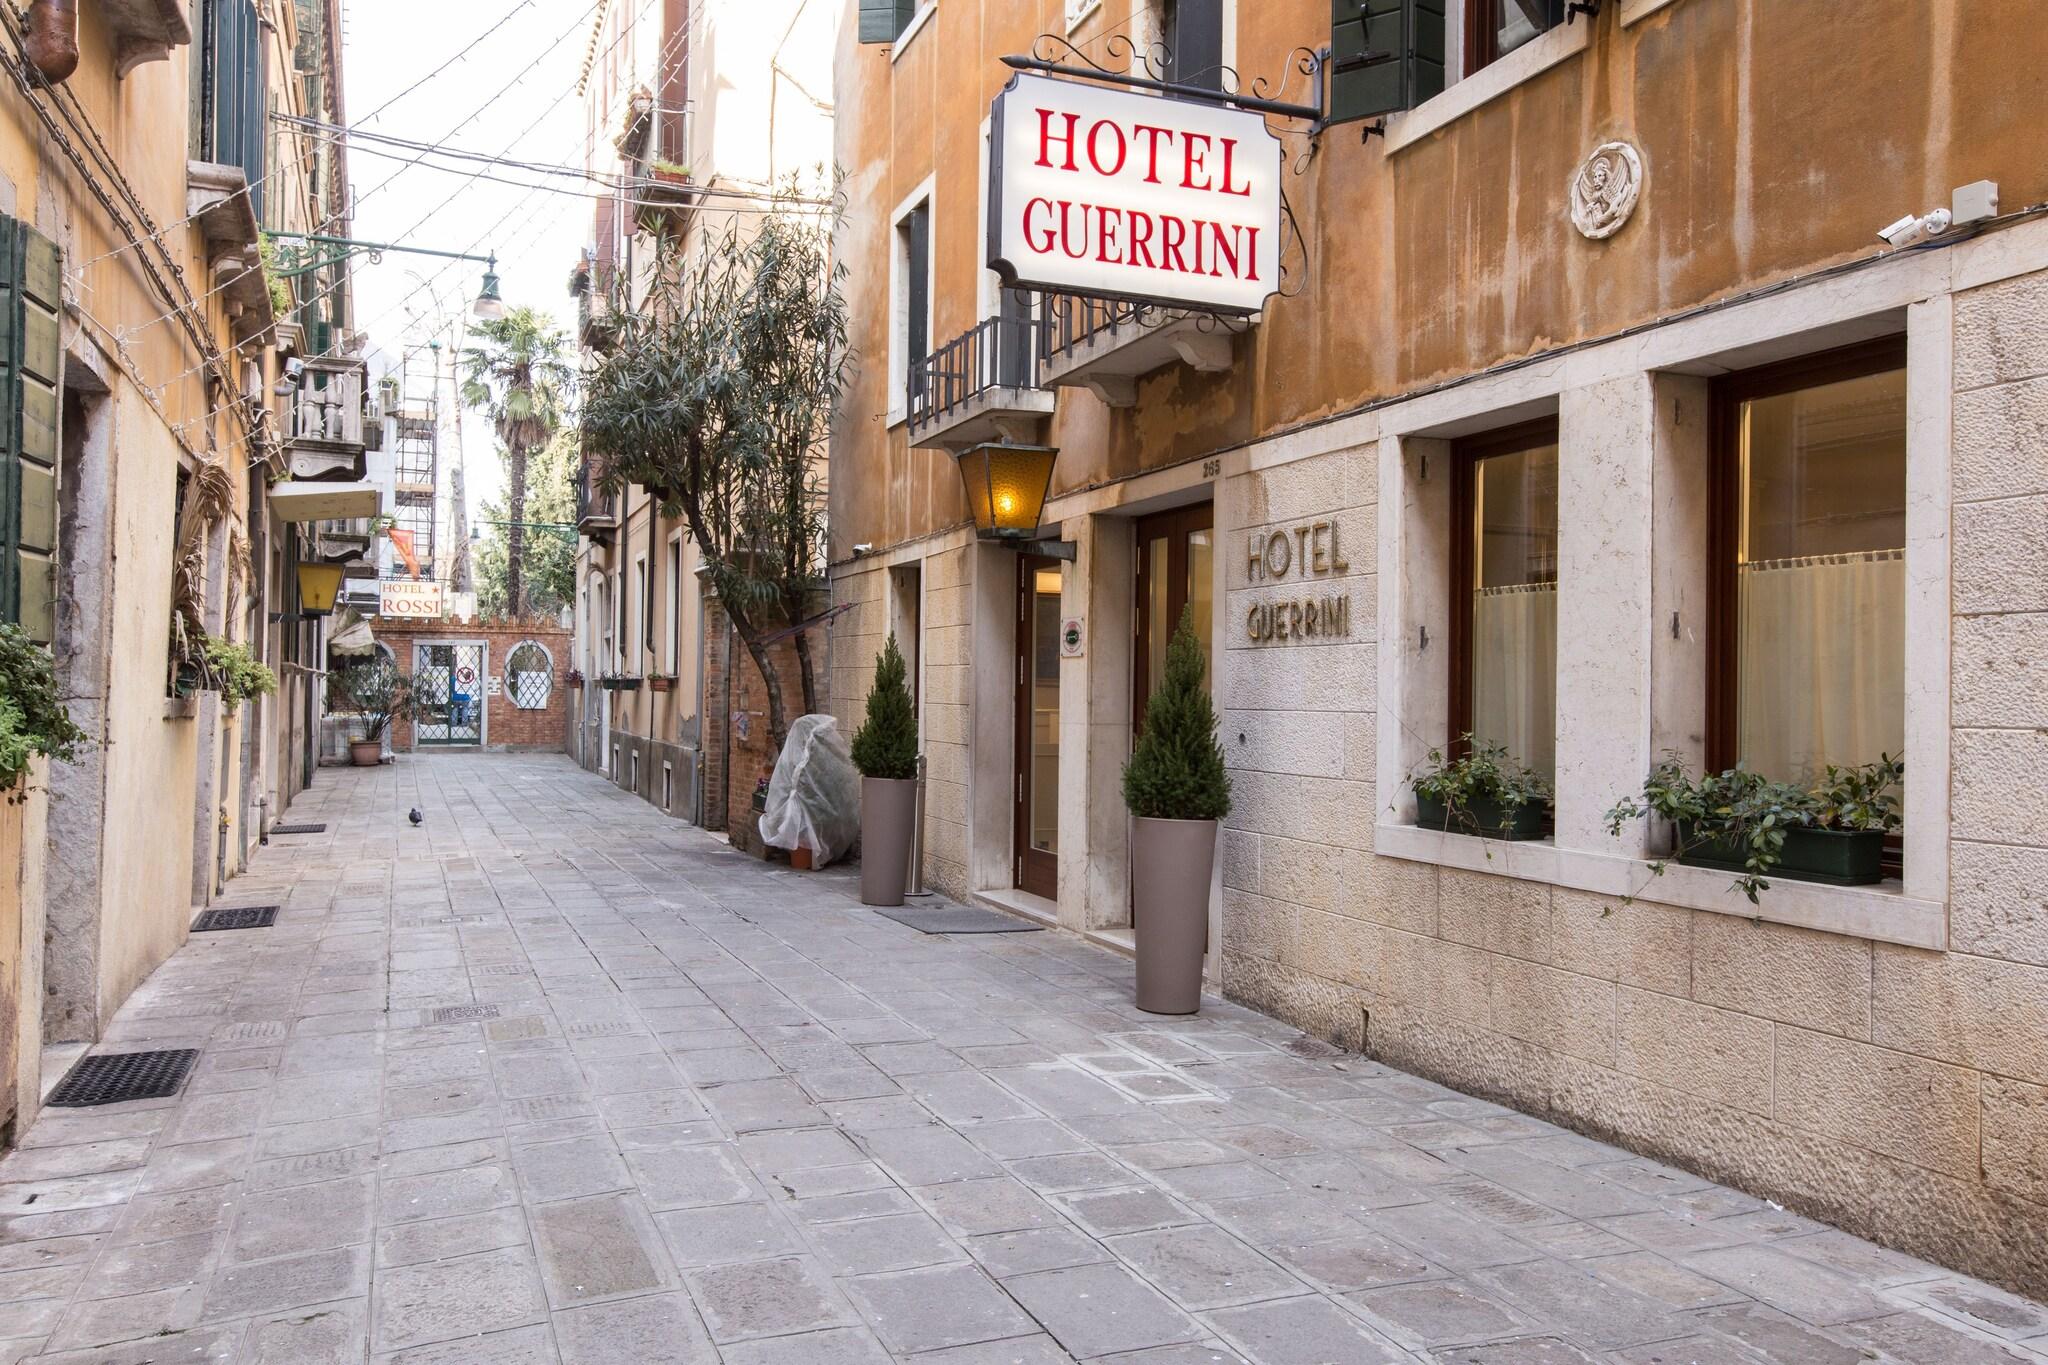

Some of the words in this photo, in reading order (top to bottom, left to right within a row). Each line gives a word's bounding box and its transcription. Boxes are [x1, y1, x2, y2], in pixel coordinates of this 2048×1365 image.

[1034, 108, 1251, 196] HOTEL
[1022, 197, 1260, 281] GUERRINI
[1203, 459, 1220, 478] 265
[1247, 519, 1349, 581] HOTEL
[382, 583, 425, 594] HOTEL
[383, 599, 439, 613] ROSSI
[1247, 596, 1350, 641] GUERRINI
